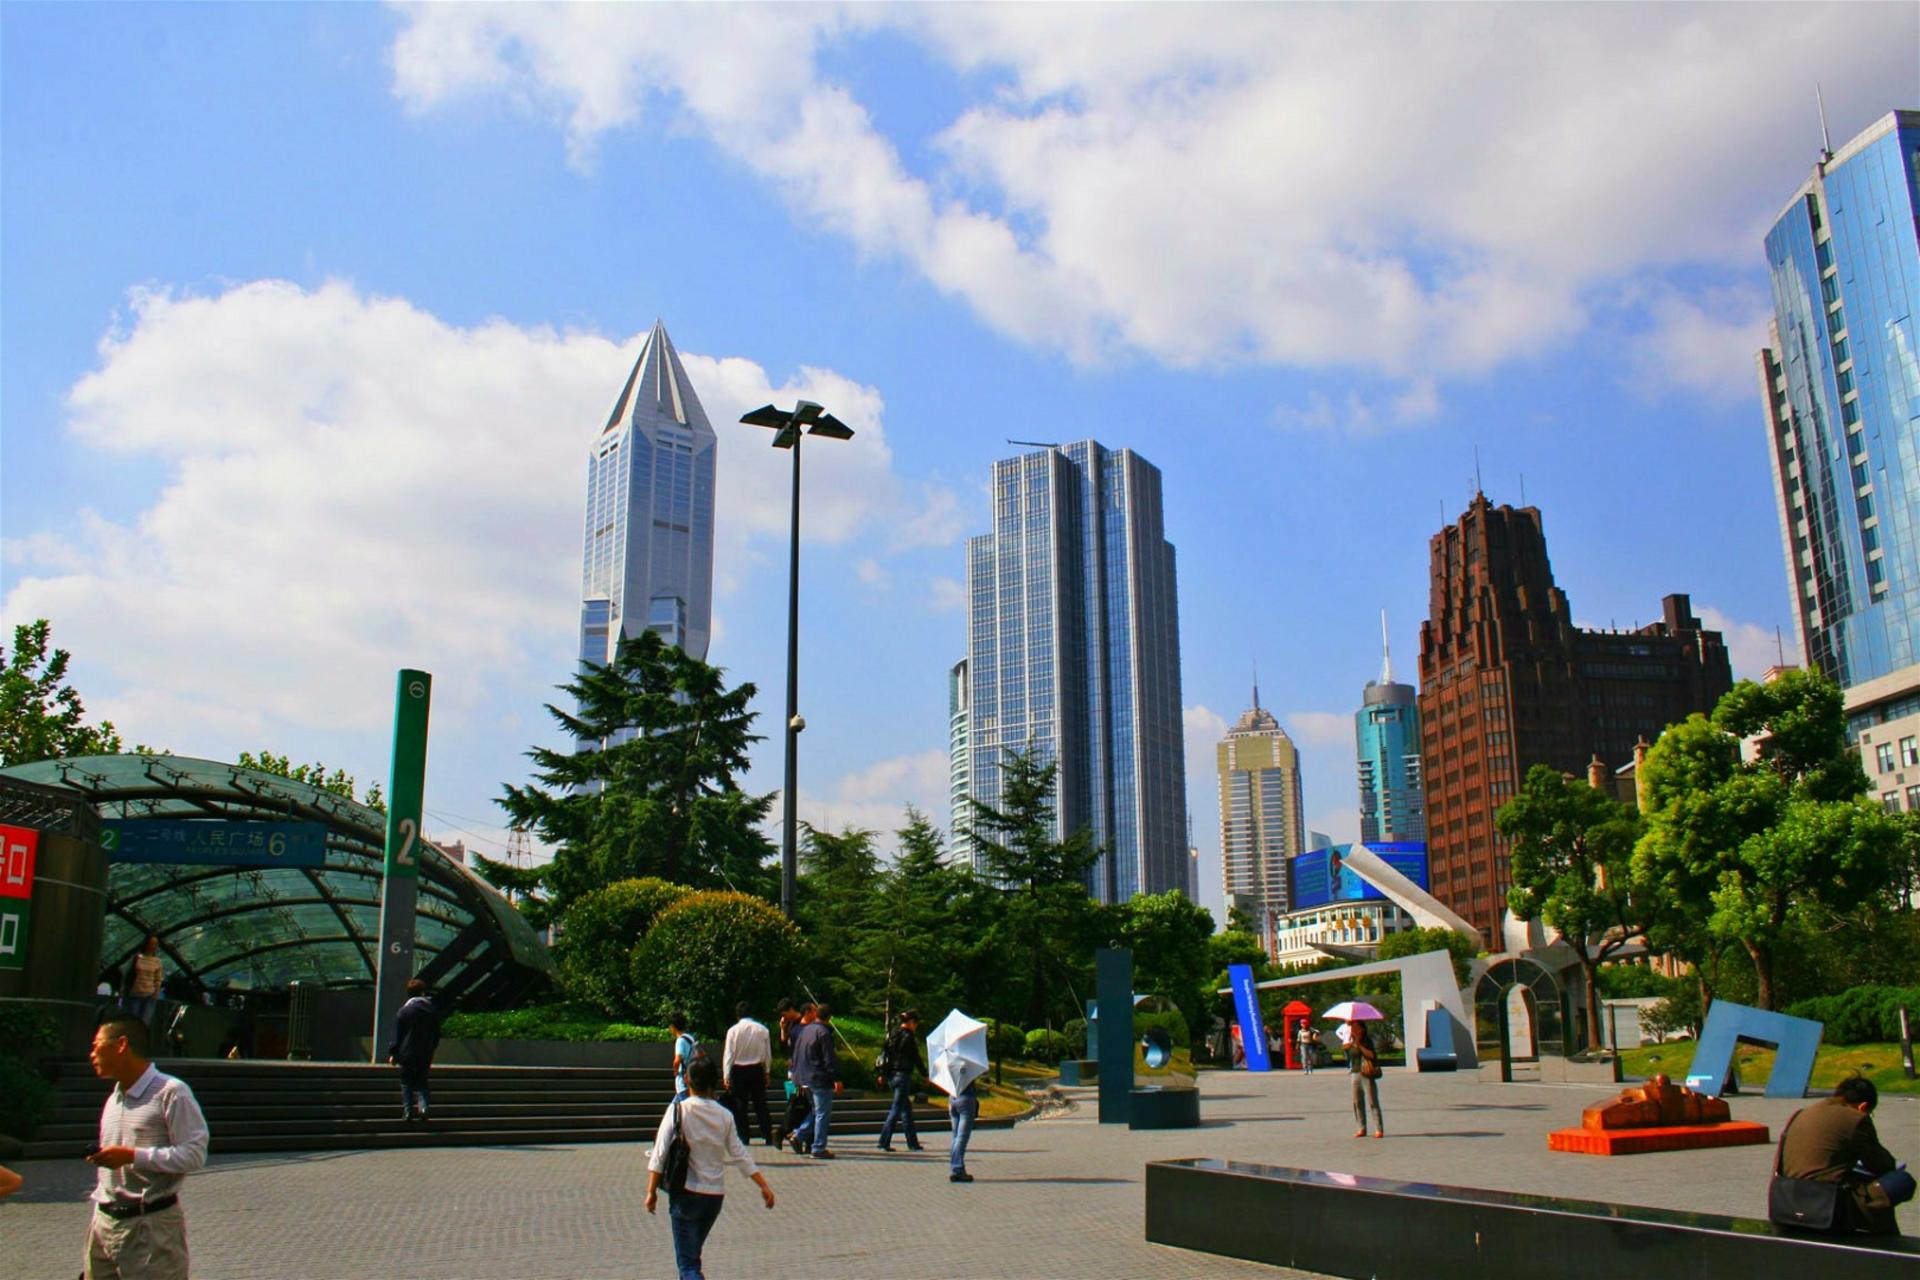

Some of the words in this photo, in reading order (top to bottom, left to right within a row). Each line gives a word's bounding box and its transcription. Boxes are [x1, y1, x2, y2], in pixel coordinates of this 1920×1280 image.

[101, 829, 116, 851] 2
[190, 829, 264, 848] 人民广场
[269, 831, 286, 857] 6
[396, 818, 416, 866] 2
